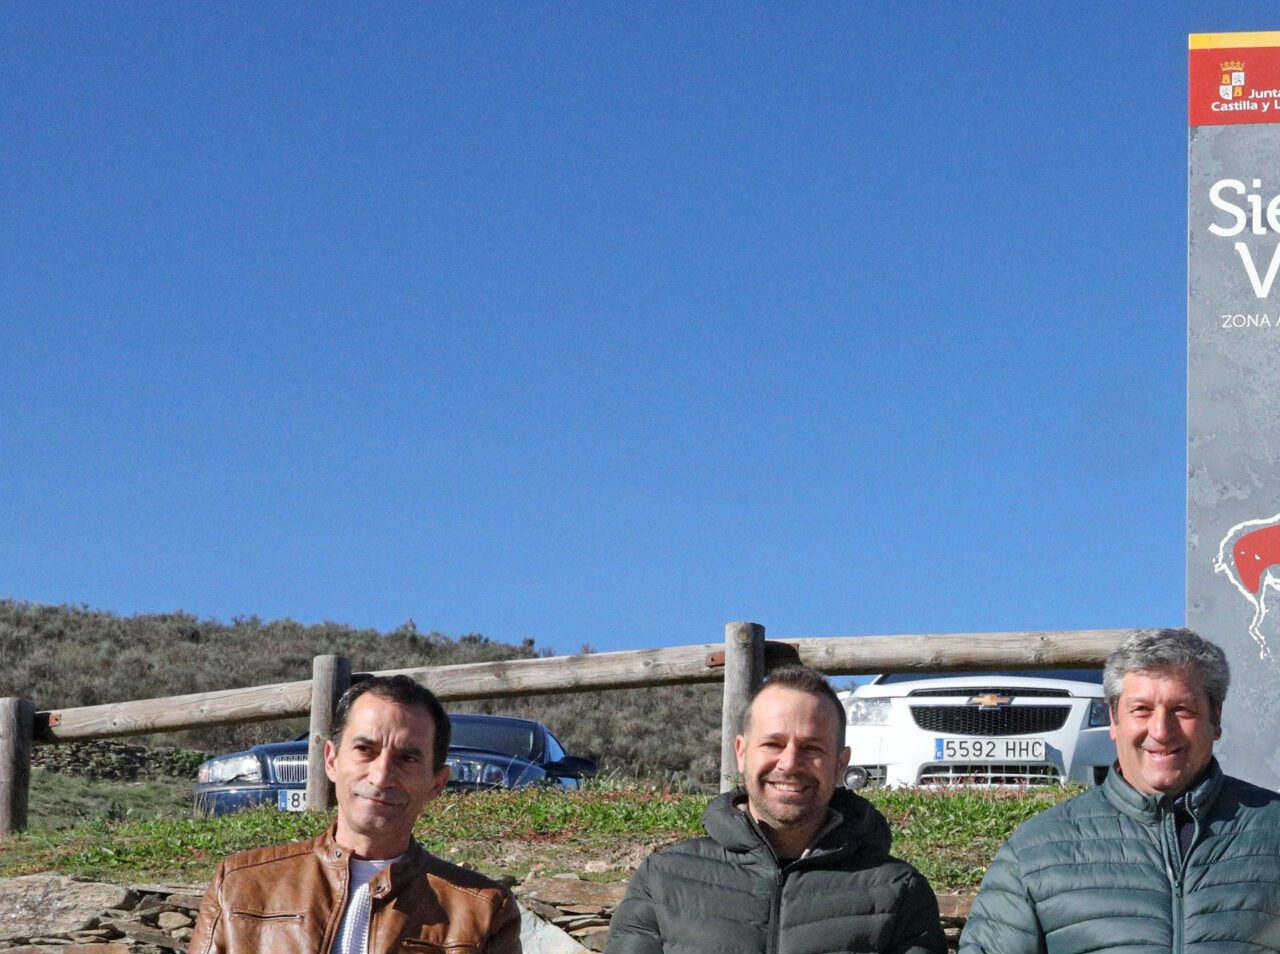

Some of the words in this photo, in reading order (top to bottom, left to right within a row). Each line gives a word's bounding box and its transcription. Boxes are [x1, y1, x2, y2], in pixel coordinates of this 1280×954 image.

[1211, 101, 1258, 111] Castilla
[1262, 101, 1270, 112] y
[1222, 314, 1271, 328] ZONA
[946, 741, 996, 758] 5592
[1006, 741, 1042, 758] HHC
